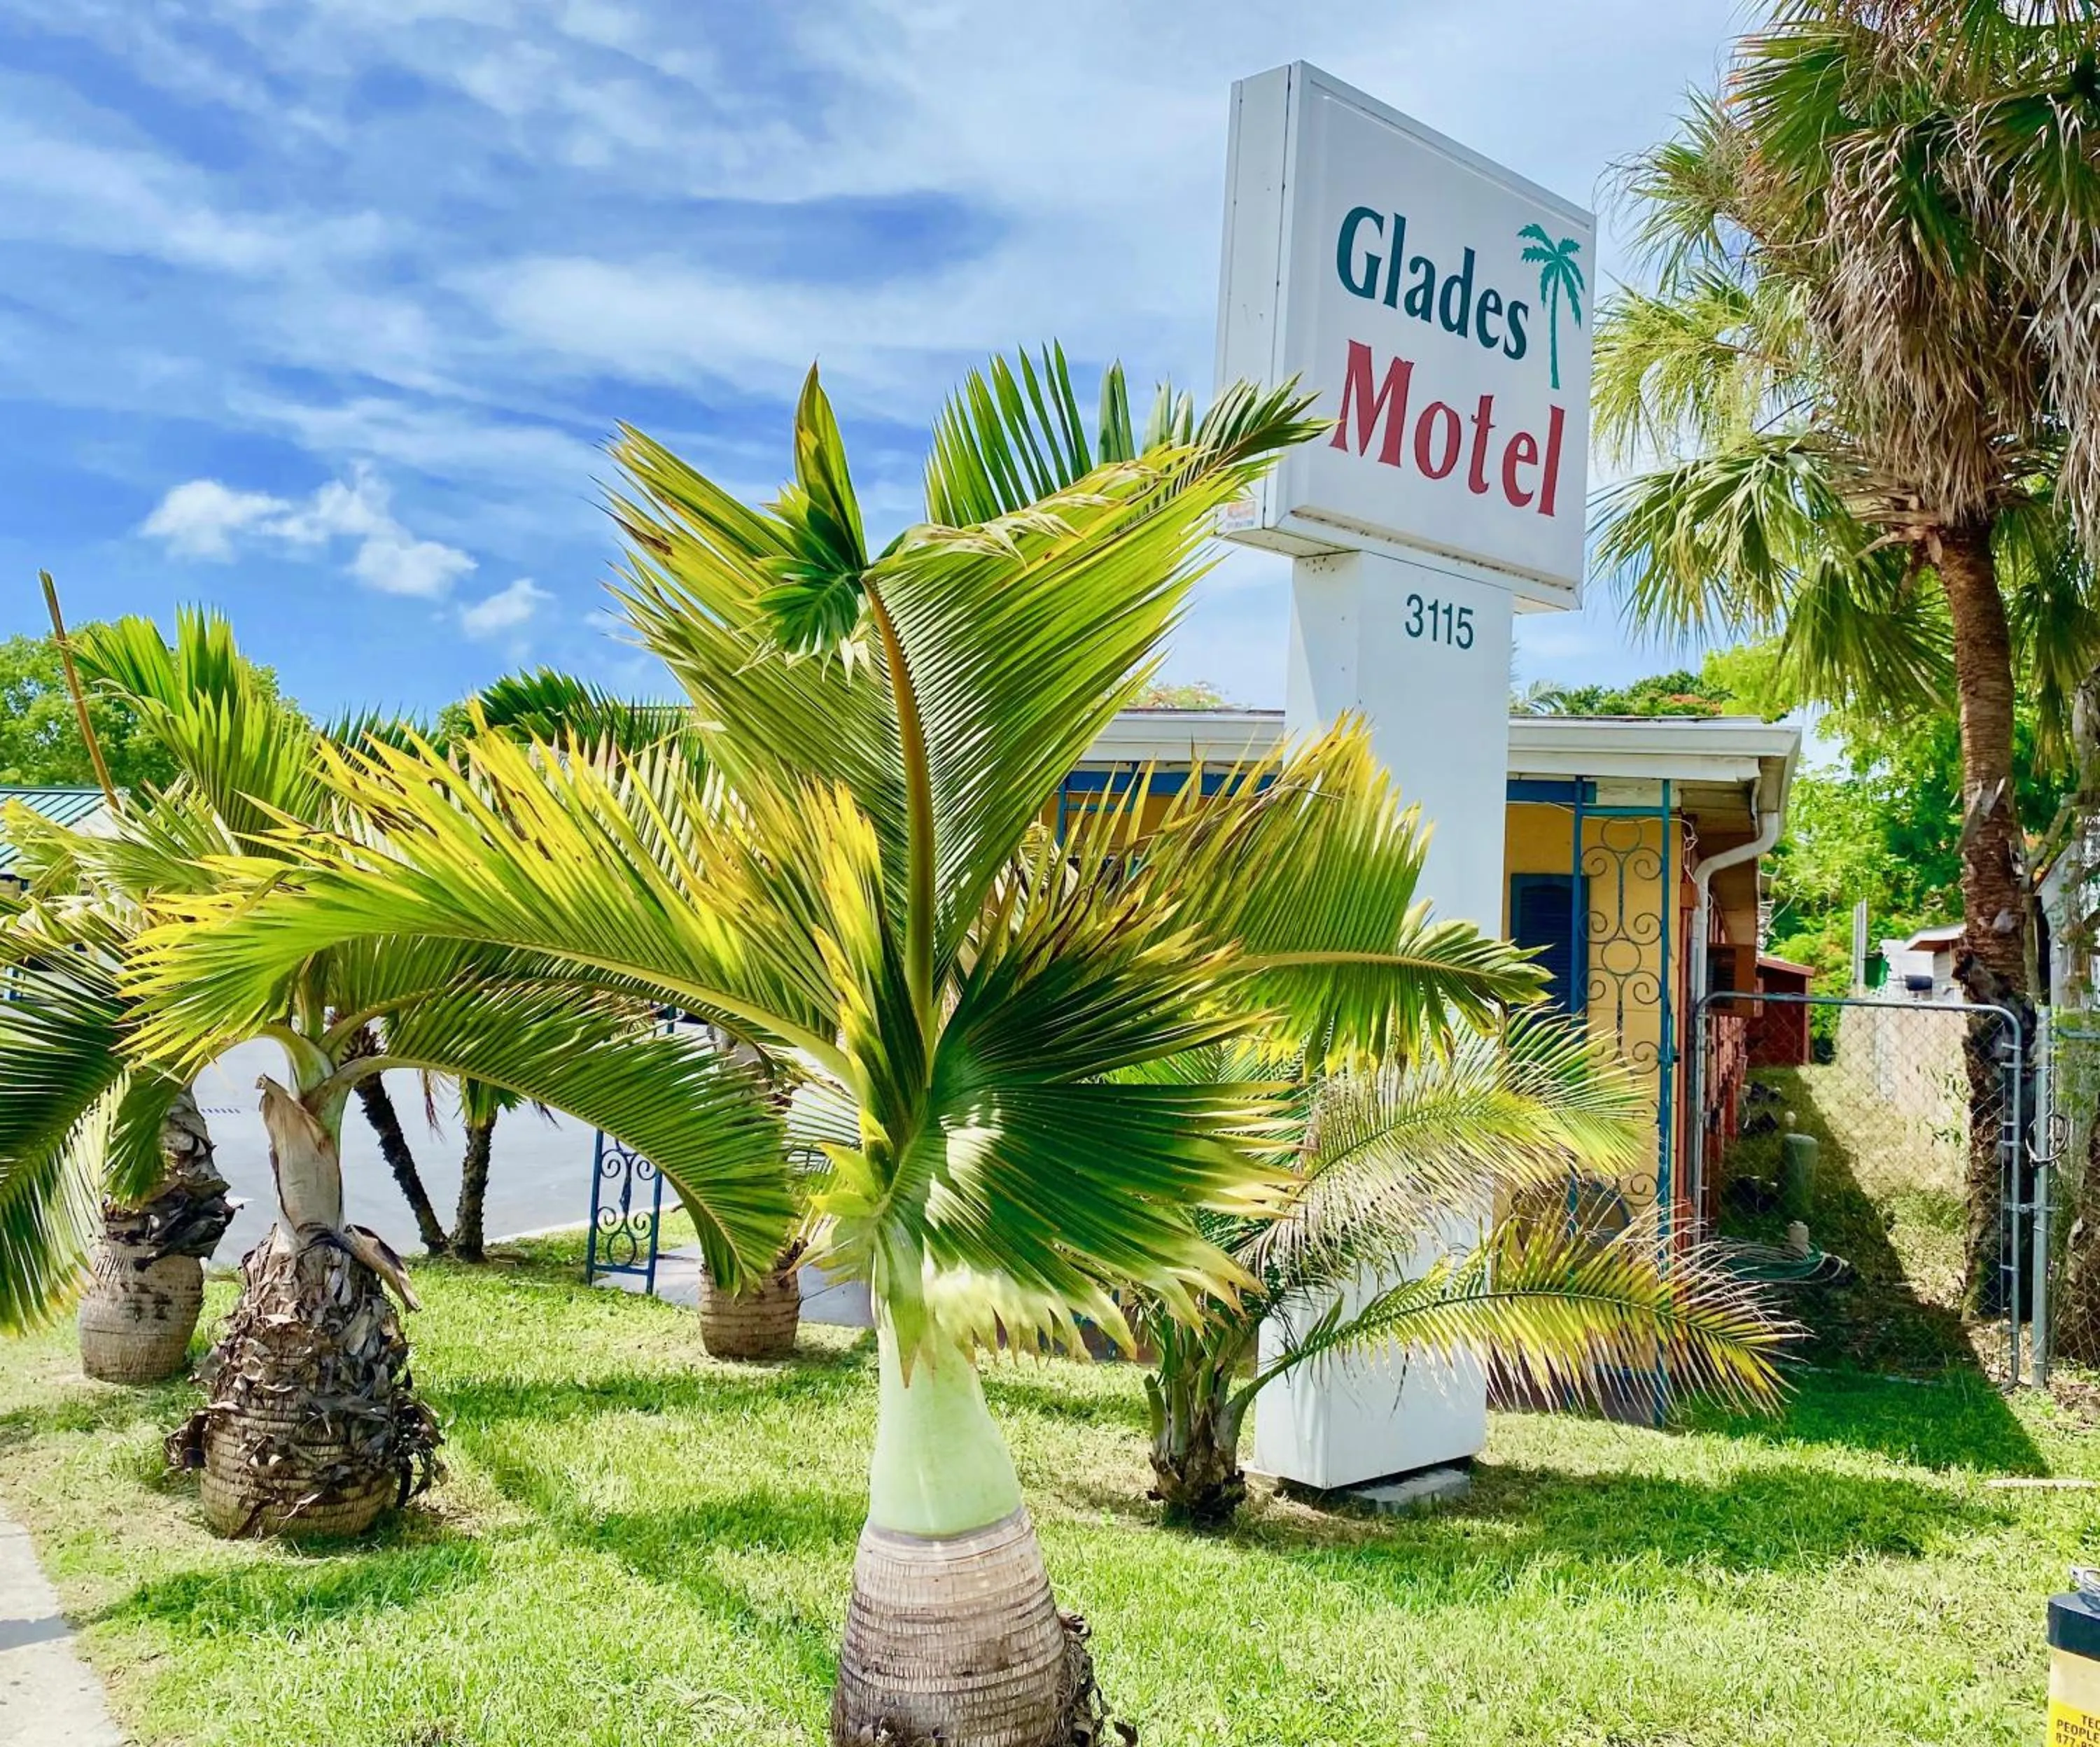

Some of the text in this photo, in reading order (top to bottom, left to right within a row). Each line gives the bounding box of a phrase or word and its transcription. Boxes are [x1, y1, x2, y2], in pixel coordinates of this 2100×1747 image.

[1336, 206, 1529, 360] Glades
[1329, 339, 1564, 517] Motel
[1406, 594, 1474, 650] 3115
